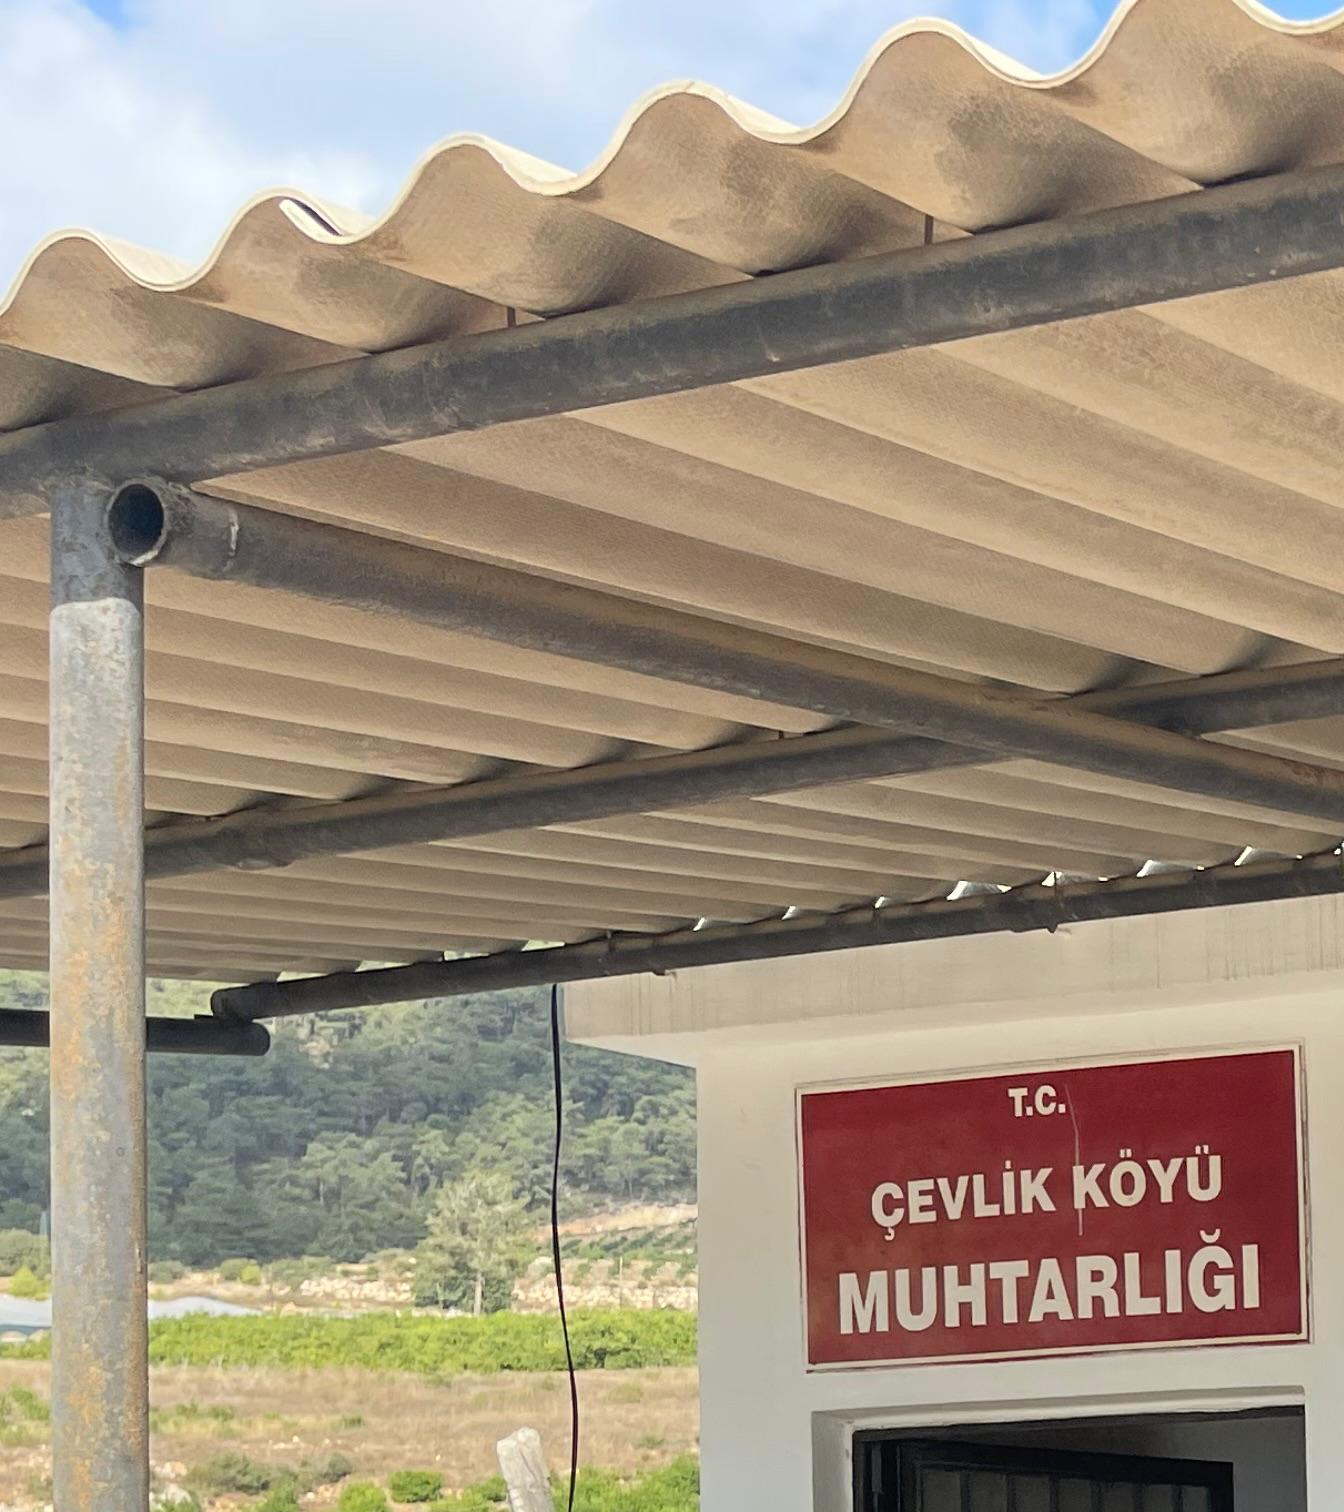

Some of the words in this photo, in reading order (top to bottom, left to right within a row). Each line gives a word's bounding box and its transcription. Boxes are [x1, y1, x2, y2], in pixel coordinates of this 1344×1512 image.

[1008, 1085, 1067, 1117] T.C.
[871, 1160, 1057, 1241] ÇEVLİK
[1073, 1145, 1222, 1210] KÖYÜ
[838, 1228, 1260, 1335] MUHTARLIĞI
